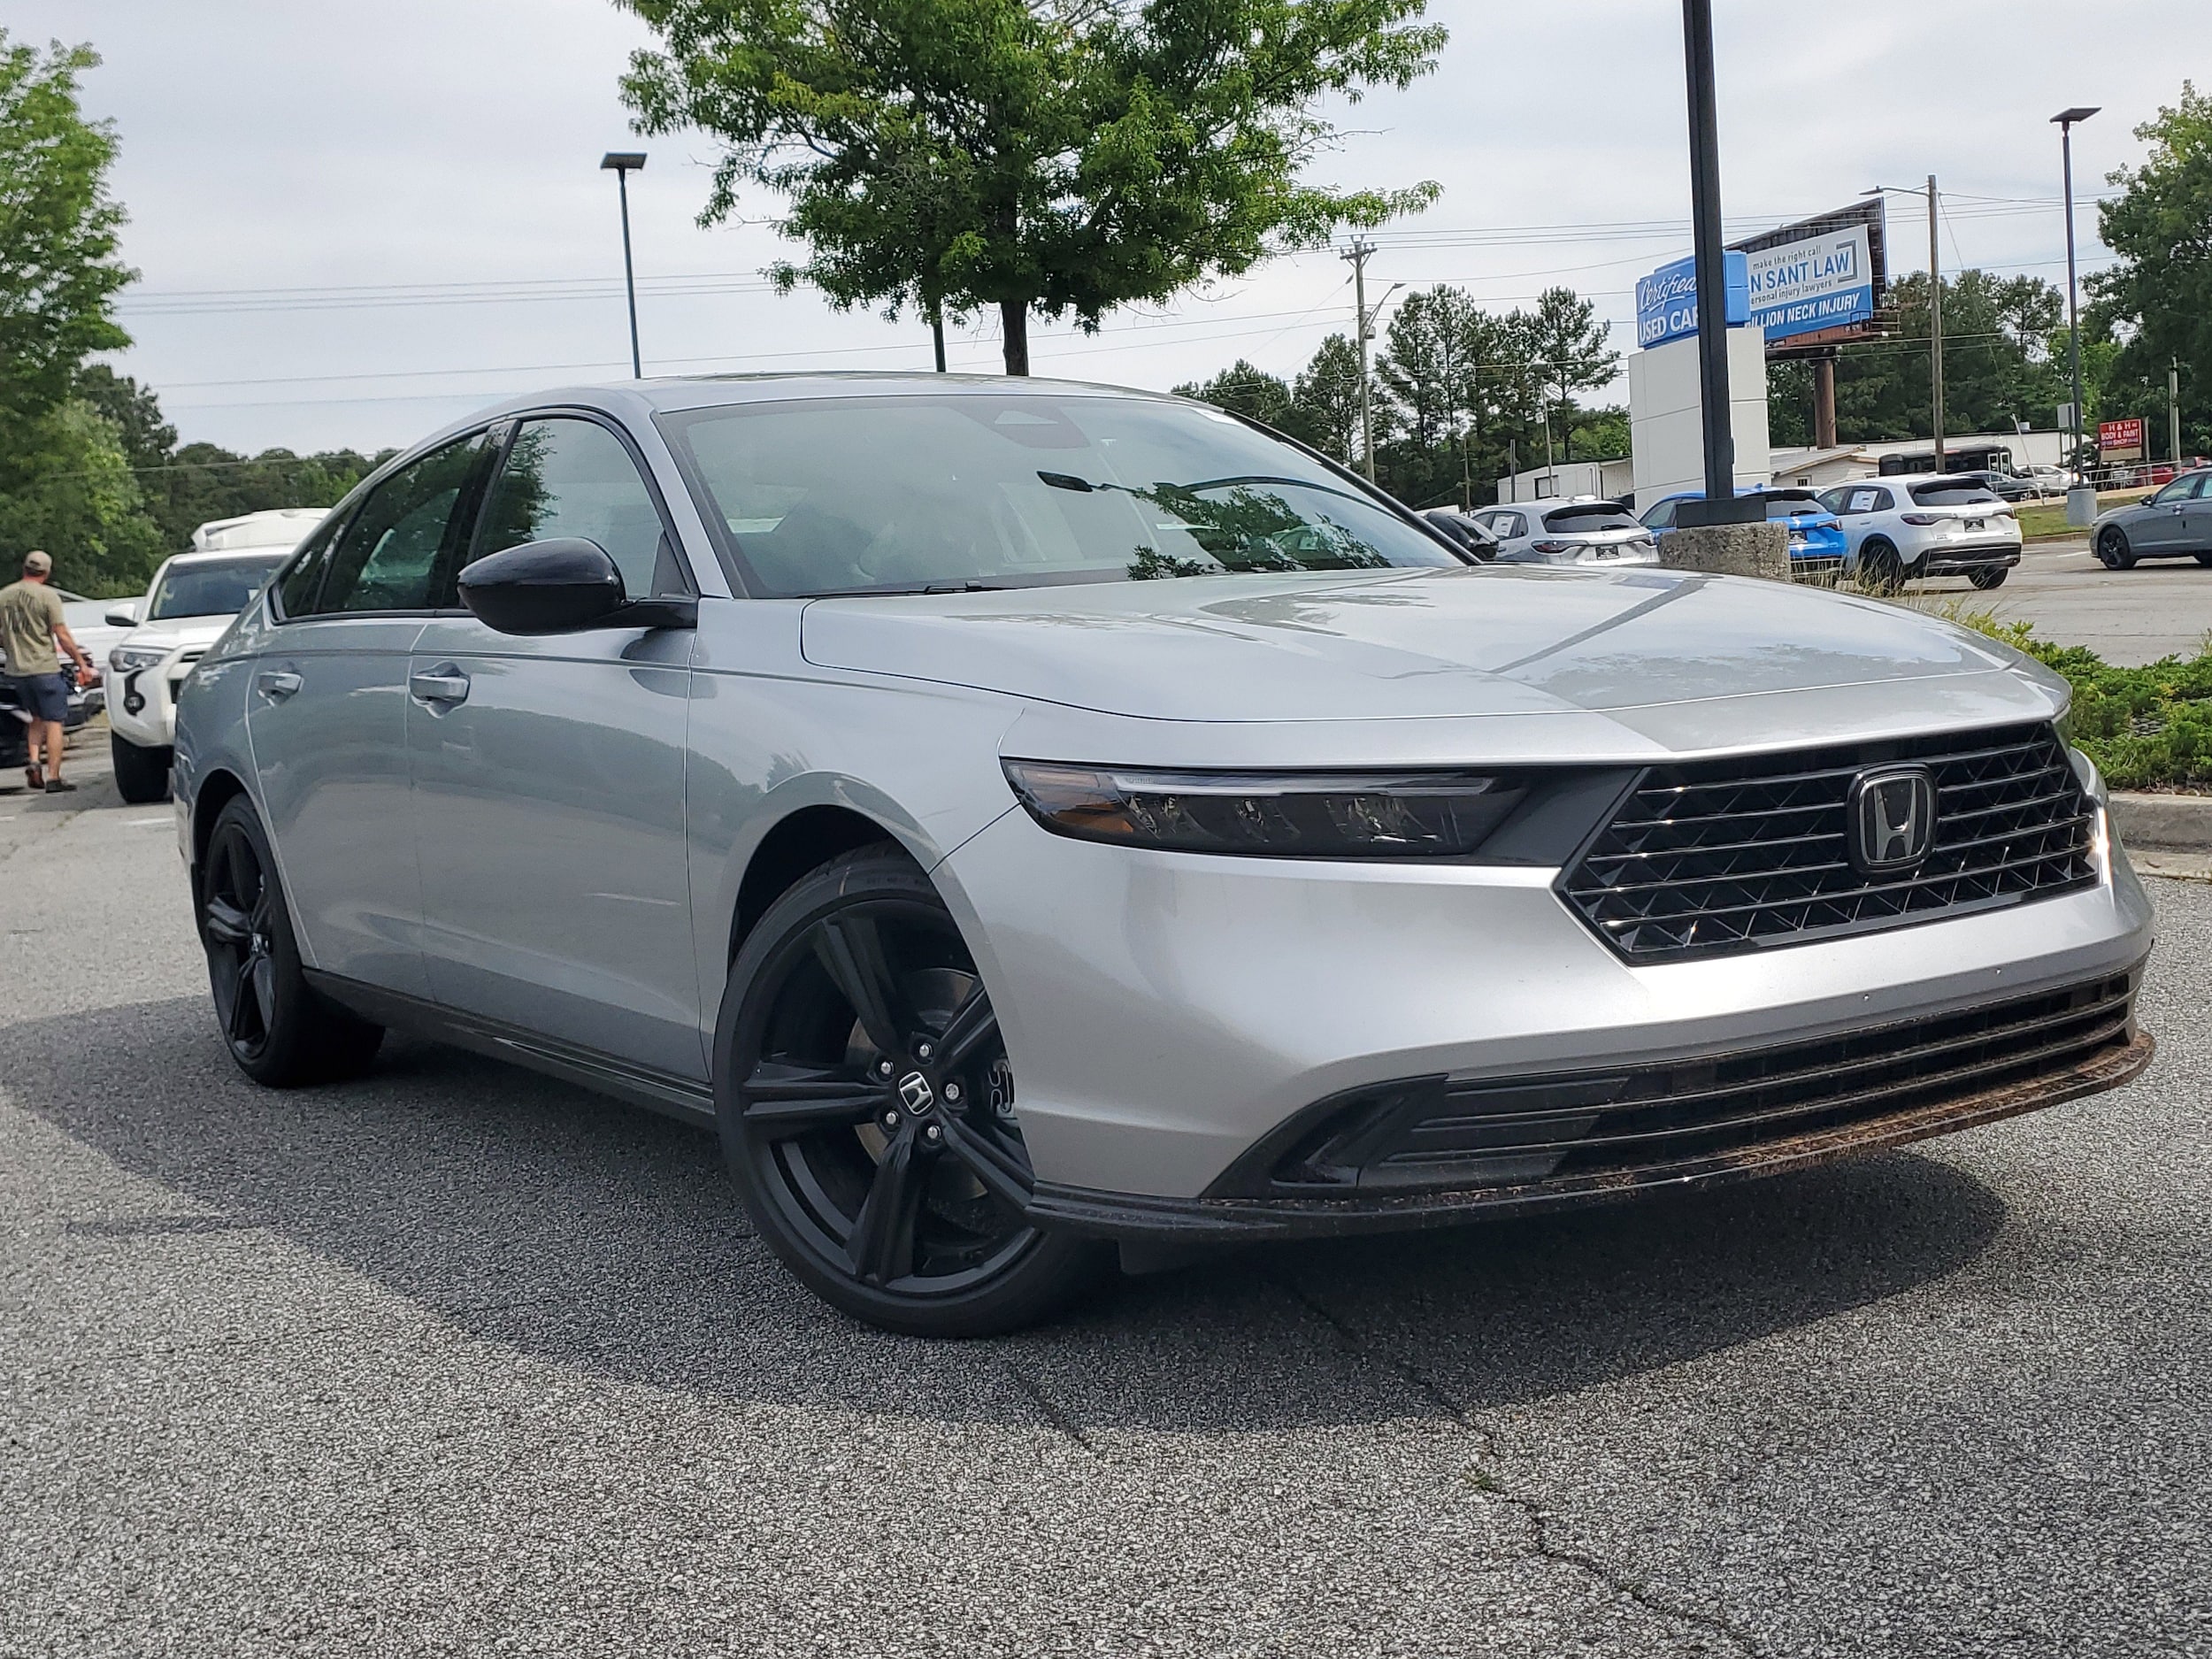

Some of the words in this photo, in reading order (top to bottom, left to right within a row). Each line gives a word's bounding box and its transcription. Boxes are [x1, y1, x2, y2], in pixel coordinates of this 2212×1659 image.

[1753, 258, 1772, 270] make
[1775, 254, 1786, 265] the
[1787, 250, 1806, 264] right
[1808, 245, 1821, 257] call
[1766, 262, 1809, 289] SANT
[1814, 251, 1850, 279] LAW
[1751, 289, 1778, 304] ersonal
[1778, 285, 1801, 300] injury
[1802, 280, 1832, 294] lawyers
[1787, 302, 1817, 324] NECK
[1818, 292, 1861, 316] INJURY
[1639, 316, 1668, 343] USED
